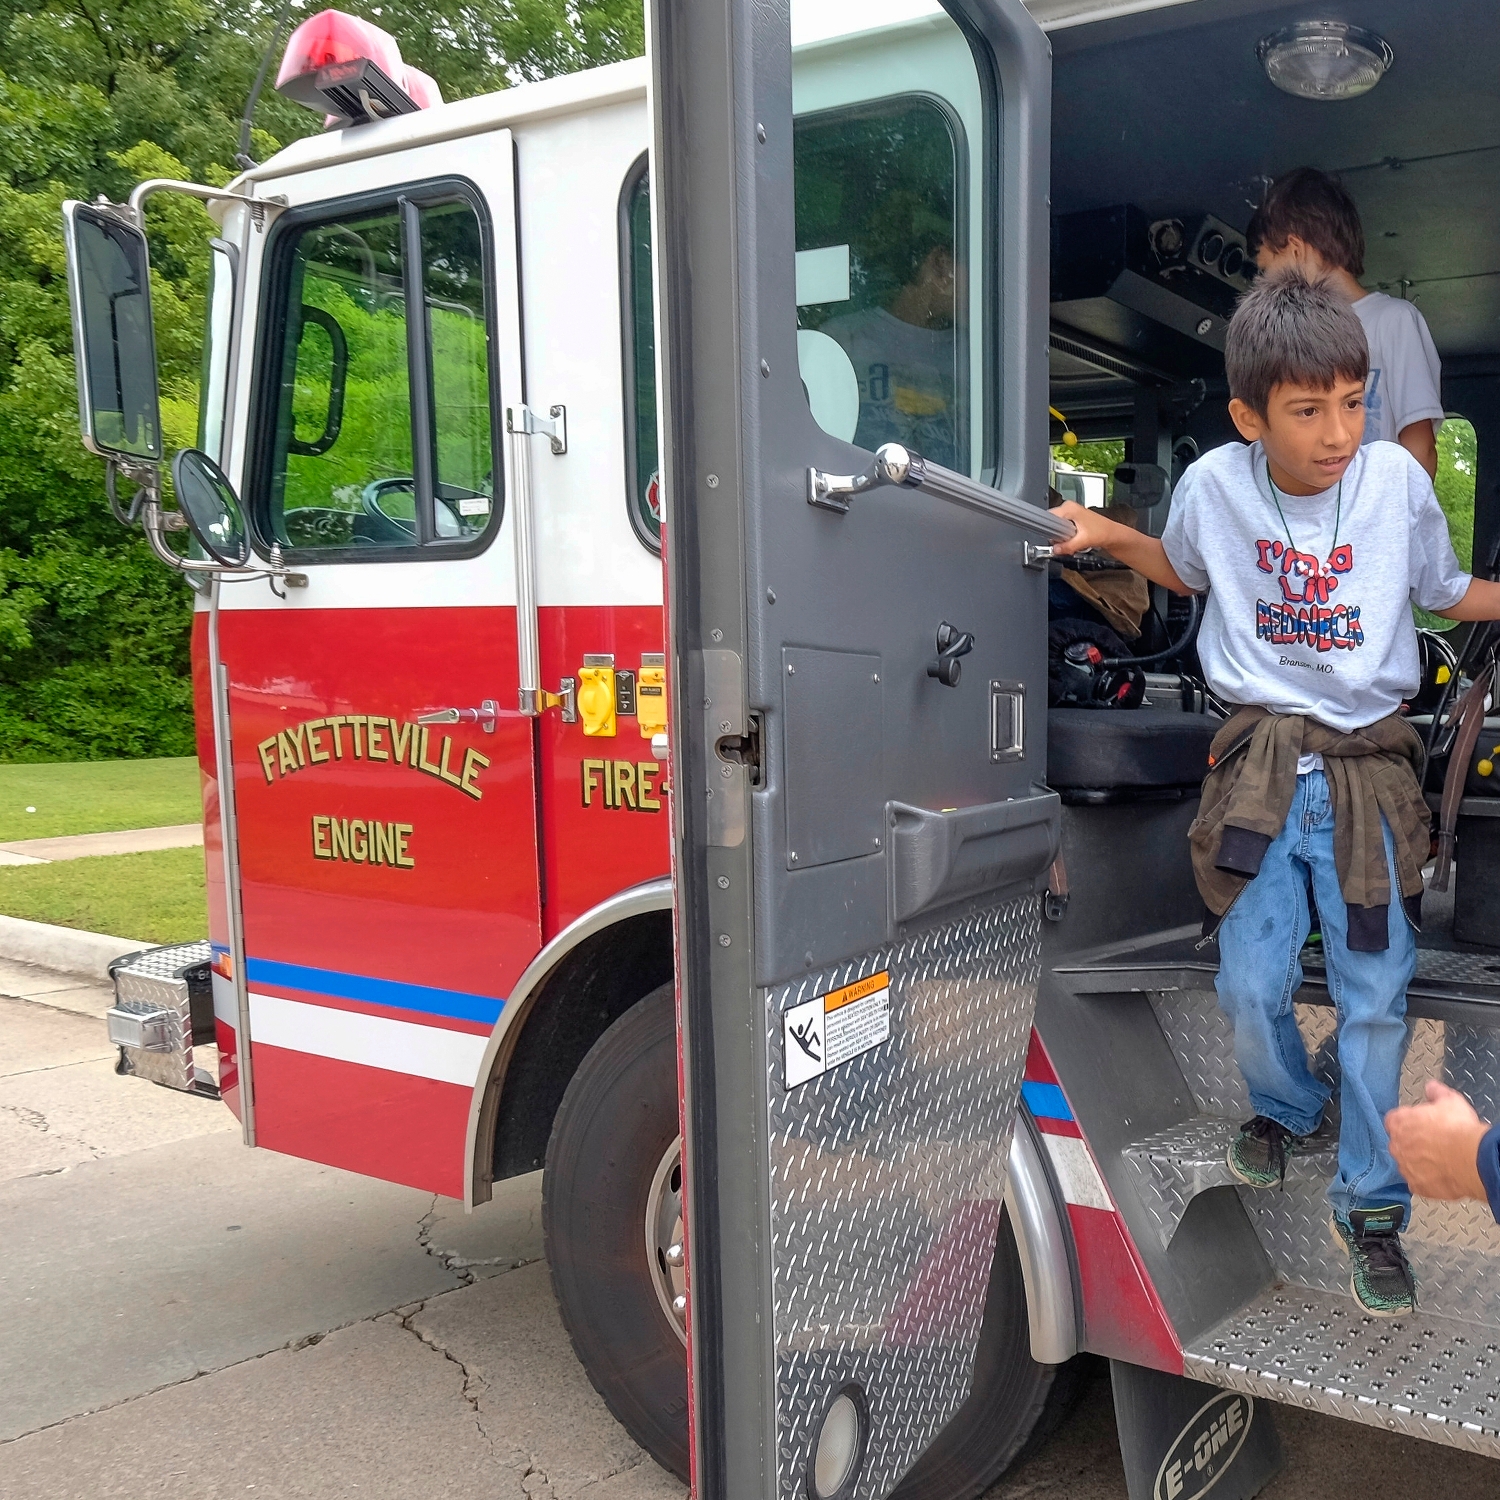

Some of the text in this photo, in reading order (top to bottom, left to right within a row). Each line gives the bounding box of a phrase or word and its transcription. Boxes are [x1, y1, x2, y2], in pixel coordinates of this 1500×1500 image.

[1256, 598, 1364, 652] REDNECK
[257, 715, 490, 801] FAYETTEVILLE
[312, 815, 415, 868] ENGINE
[848, 980, 874, 998] WARNING
[1166, 1399, 1244, 1500] E-ONE
